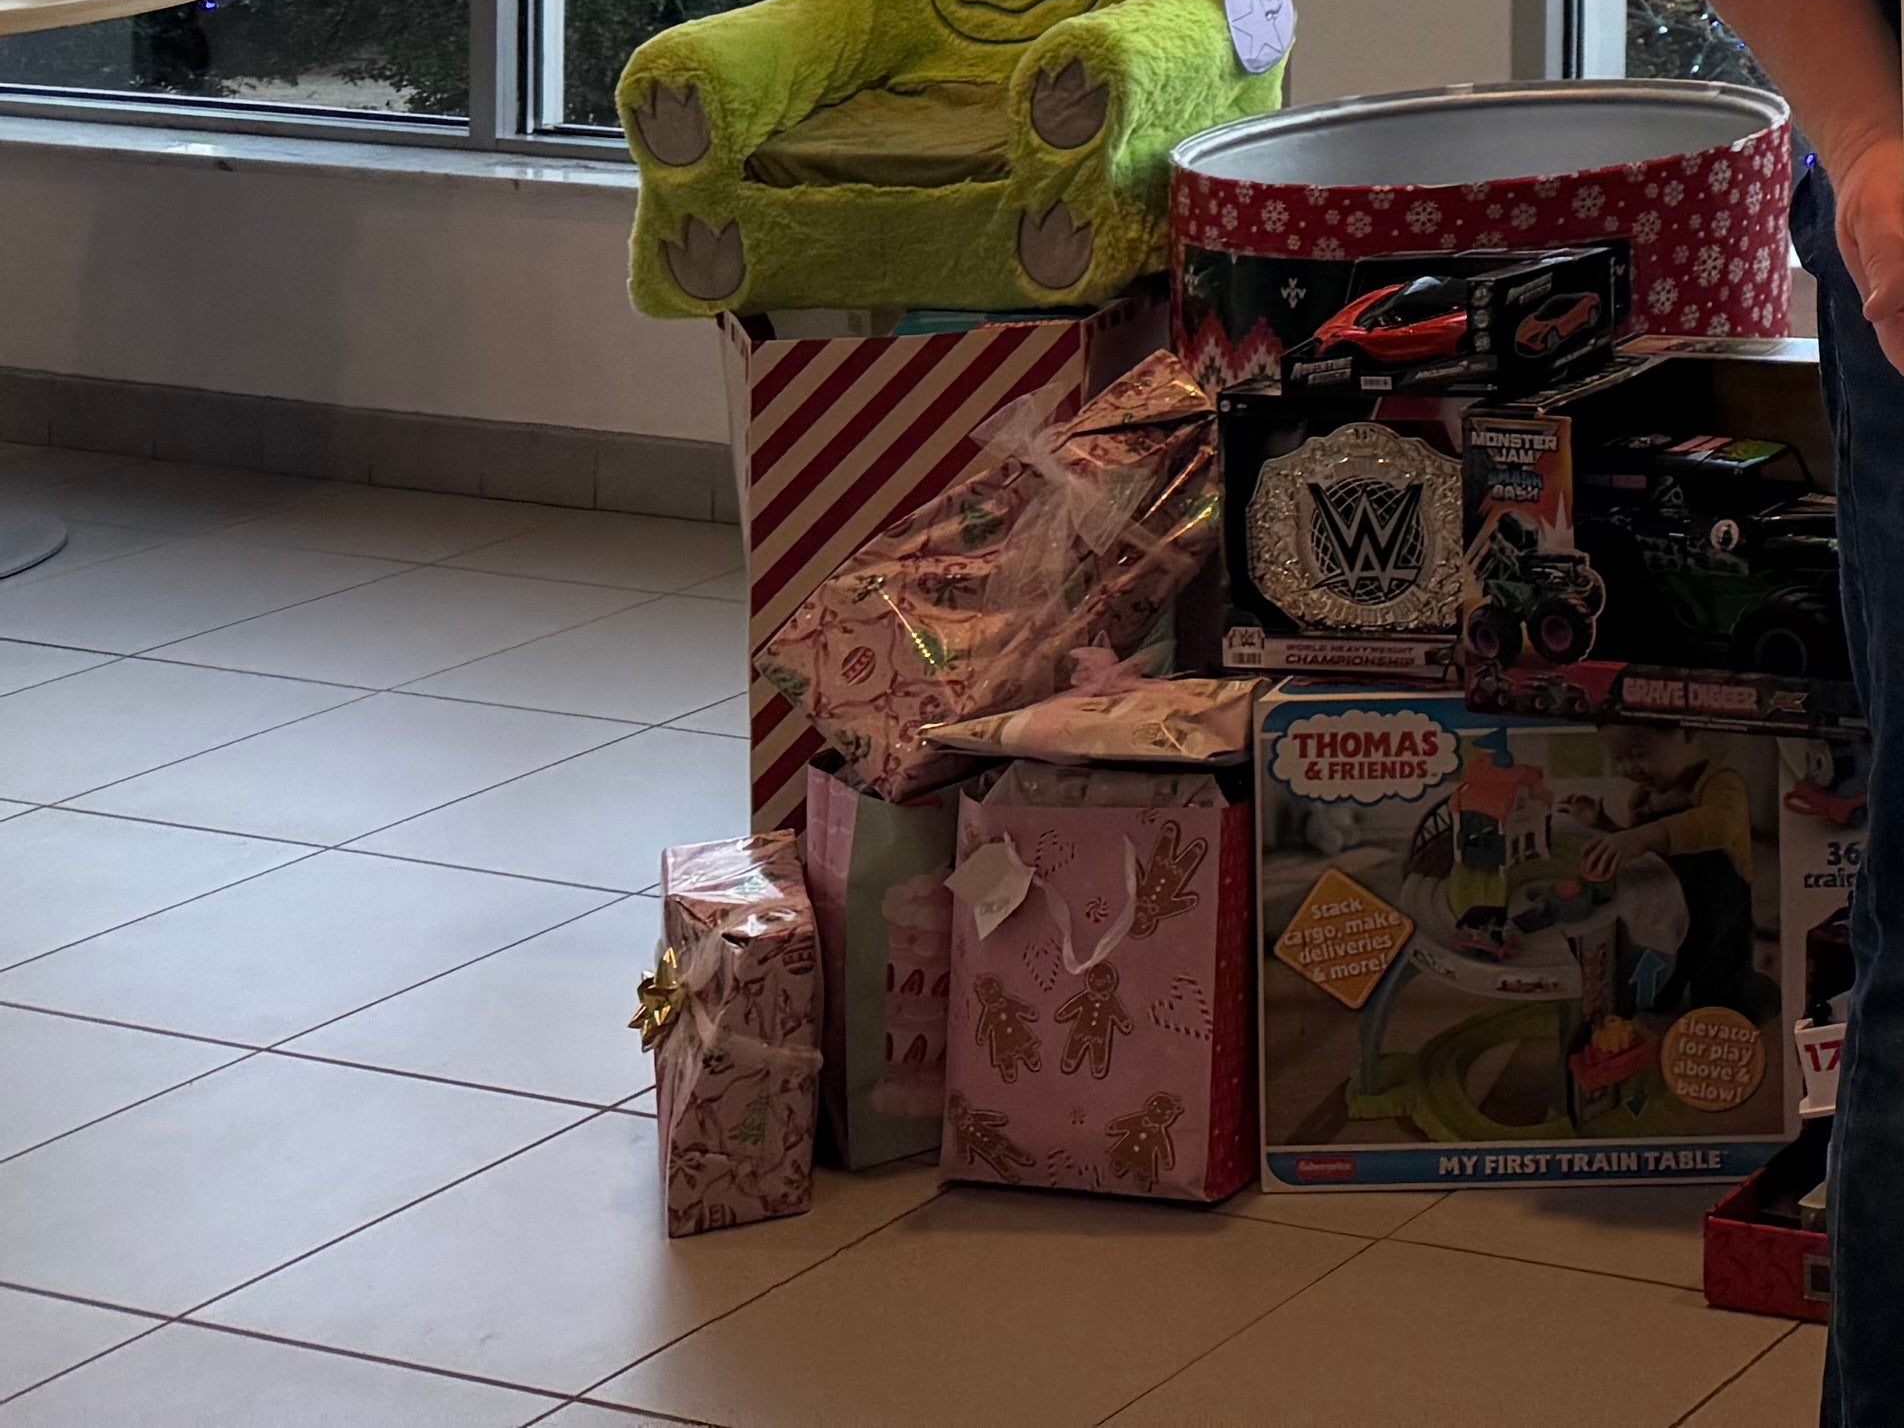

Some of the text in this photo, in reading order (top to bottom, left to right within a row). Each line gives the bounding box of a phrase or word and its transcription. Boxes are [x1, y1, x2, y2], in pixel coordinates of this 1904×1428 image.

[1471, 431, 1558, 450] MONSTER
[1490, 449, 1542, 464] JAM
[1285, 653, 1415, 667] CHAMPIONSHIP
[1622, 678, 1686, 705] GRAVE
[1688, 681, 1760, 711] DIGGER
[1292, 730, 1438, 759] THOMAS
[1304, 759, 1428, 781] & FRIENDS
[1311, 896, 1362, 919] Stack
[1283, 911, 1400, 947] cargo, make
[1300, 934, 1392, 964] deliveries
[1330, 955, 1388, 979] more!
[1680, 1018, 1760, 1043] Elevator
[1680, 1036, 1754, 1066] for play
[1672, 1060, 1733, 1080] above
[1676, 1078, 1743, 1102] below!
[1439, 1151, 1721, 1175] MY FIRST TRAIN TABLE
